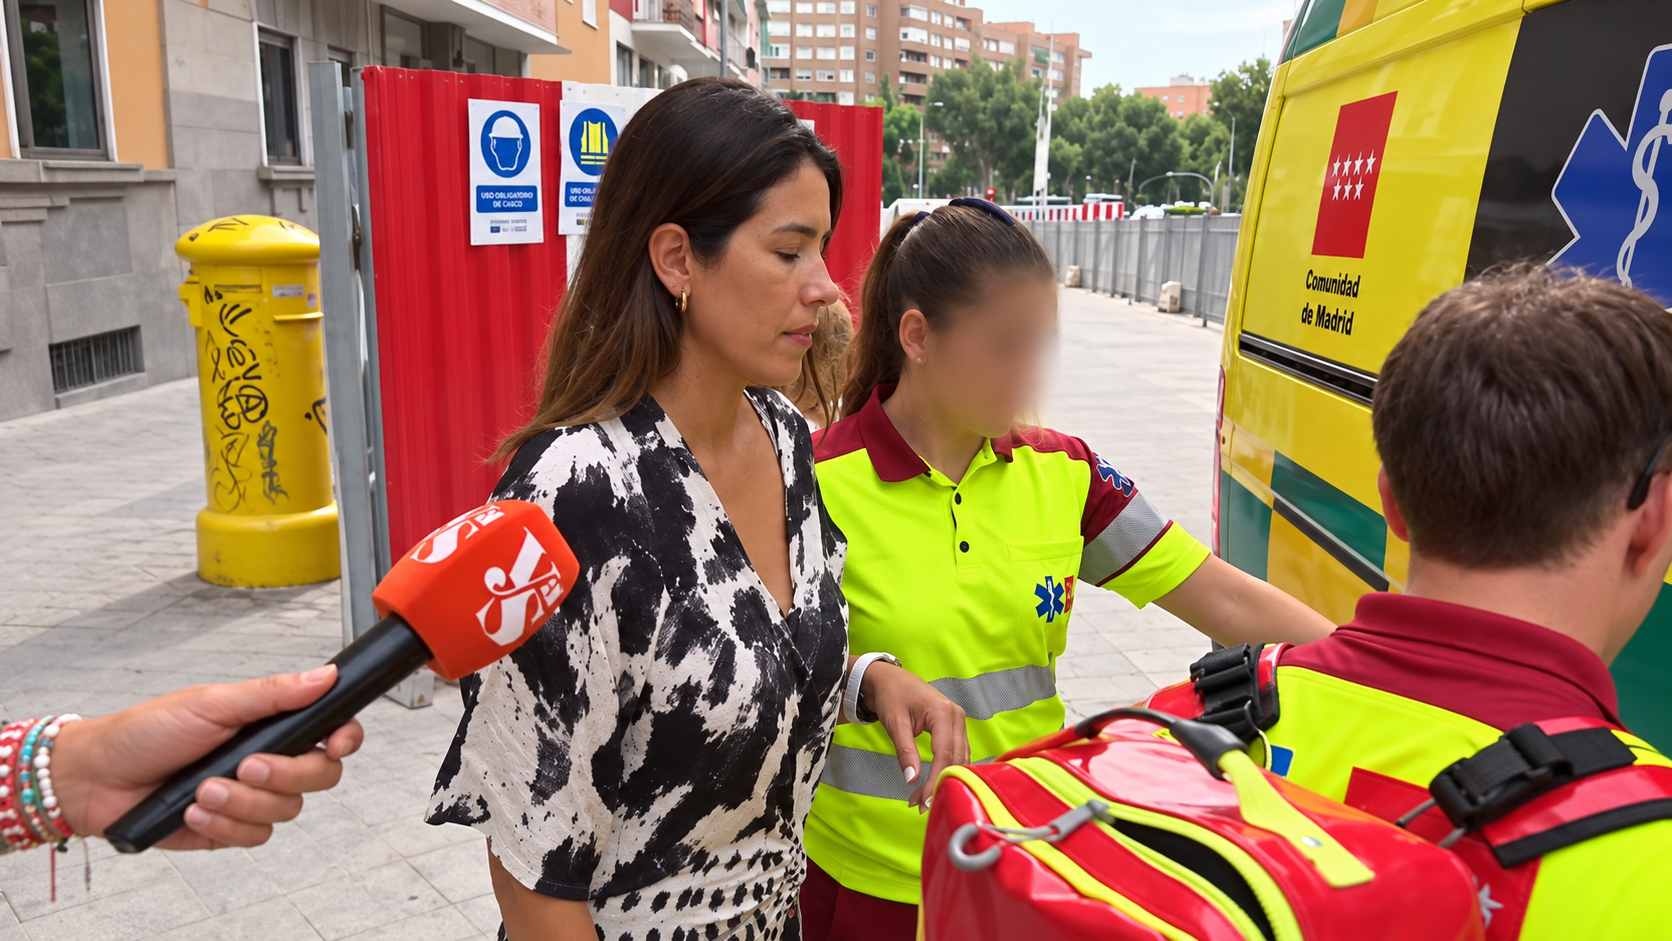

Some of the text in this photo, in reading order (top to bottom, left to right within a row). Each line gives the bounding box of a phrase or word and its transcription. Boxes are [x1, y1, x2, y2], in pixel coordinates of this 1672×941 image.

[480, 191, 534, 199] USO OBLIGATORIO
[492, 200, 523, 208] DE CASCO
[1305, 269, 1361, 298] Comunidad
[1301, 302, 1355, 335] de Madrid
